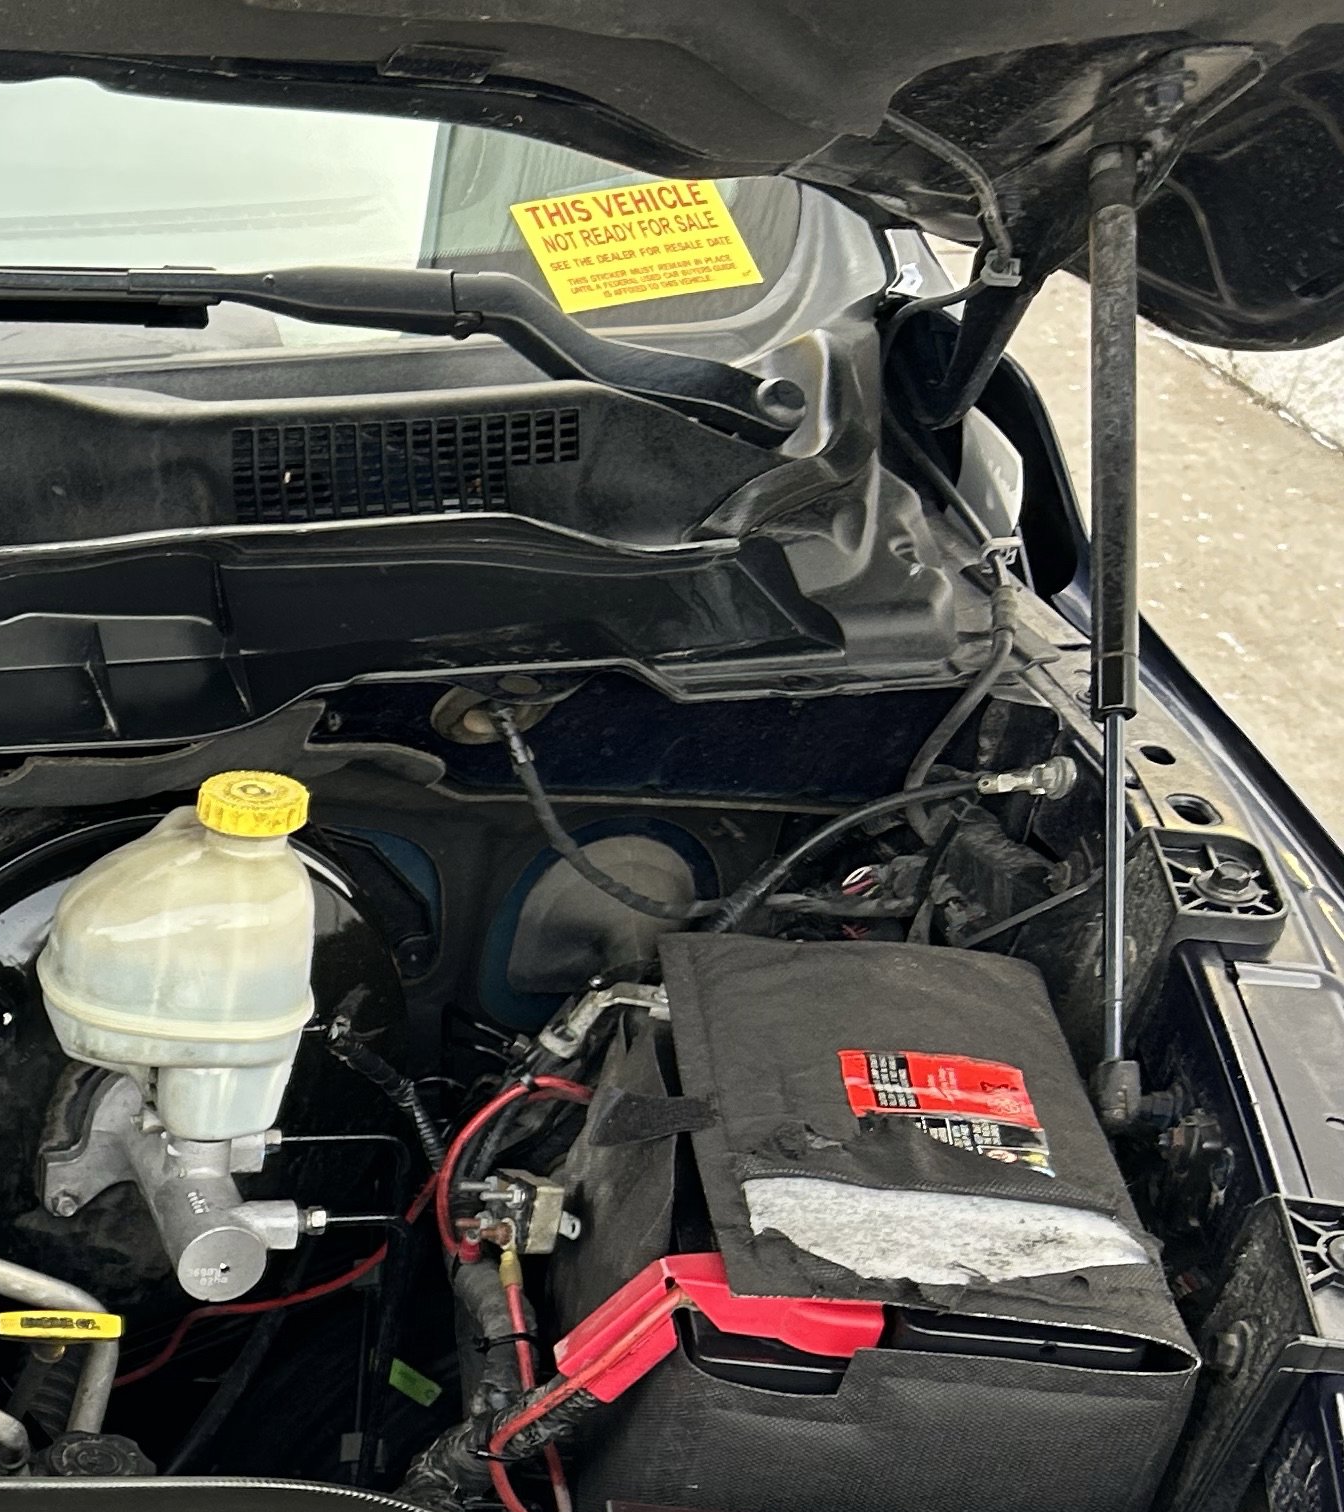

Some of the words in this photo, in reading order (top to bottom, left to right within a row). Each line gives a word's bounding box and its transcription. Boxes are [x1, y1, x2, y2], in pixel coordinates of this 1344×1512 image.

[524, 200, 595, 229] THIS
[591, 182, 708, 218] VEHICLE
[541, 232, 580, 253] NOT
[578, 223, 639, 246] READY
[637, 217, 675, 237] FOR
[673, 211, 719, 232] SALE
[550, 261, 570, 271] SEE
[573, 257, 595, 267] THE
[596, 251, 637, 263] DEALER
[639, 247, 661, 256] FOR
[664, 240, 704, 253] RESALE
[707, 236, 732, 246] DATE
[567, 277, 588, 285] THIS
[590, 271, 627, 281] STICKER
[630, 266, 655, 275] MUST
[704, 254, 731, 264] PLACE
